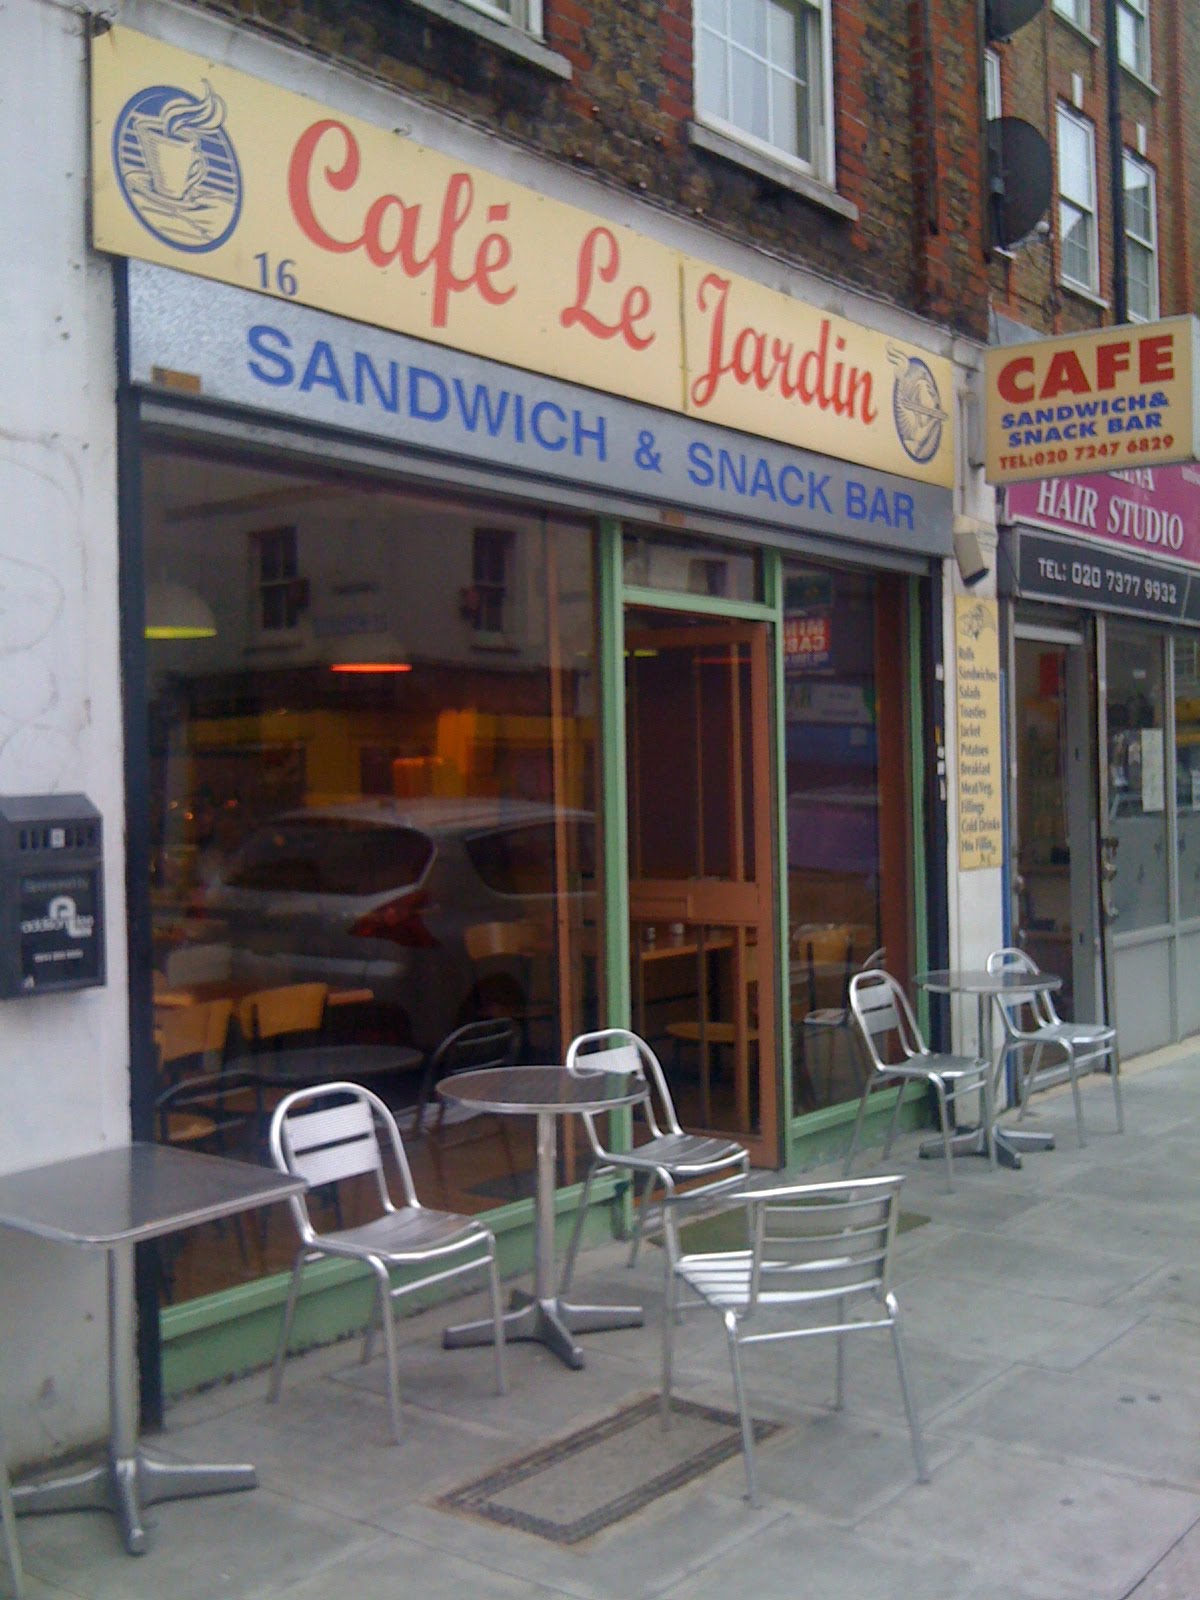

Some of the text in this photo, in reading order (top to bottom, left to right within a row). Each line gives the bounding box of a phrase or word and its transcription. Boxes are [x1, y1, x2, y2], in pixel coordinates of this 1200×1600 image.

[253, 252, 298, 297] 16
[287, 118, 878, 427] Café Le Jardin
[997, 334, 1174, 404] CAFE
[247, 324, 916, 531] SANDWICH & SNACK BAR
[1009, 412, 1162, 448] SNACK BAR
[1074, 442, 1120, 462] 7247
[1126, 434, 1174, 454] 6829
[1036, 479, 1184, 551] HAIR STUDIO
[1038, 557, 1178, 605] TEL: 020 7377 9932
